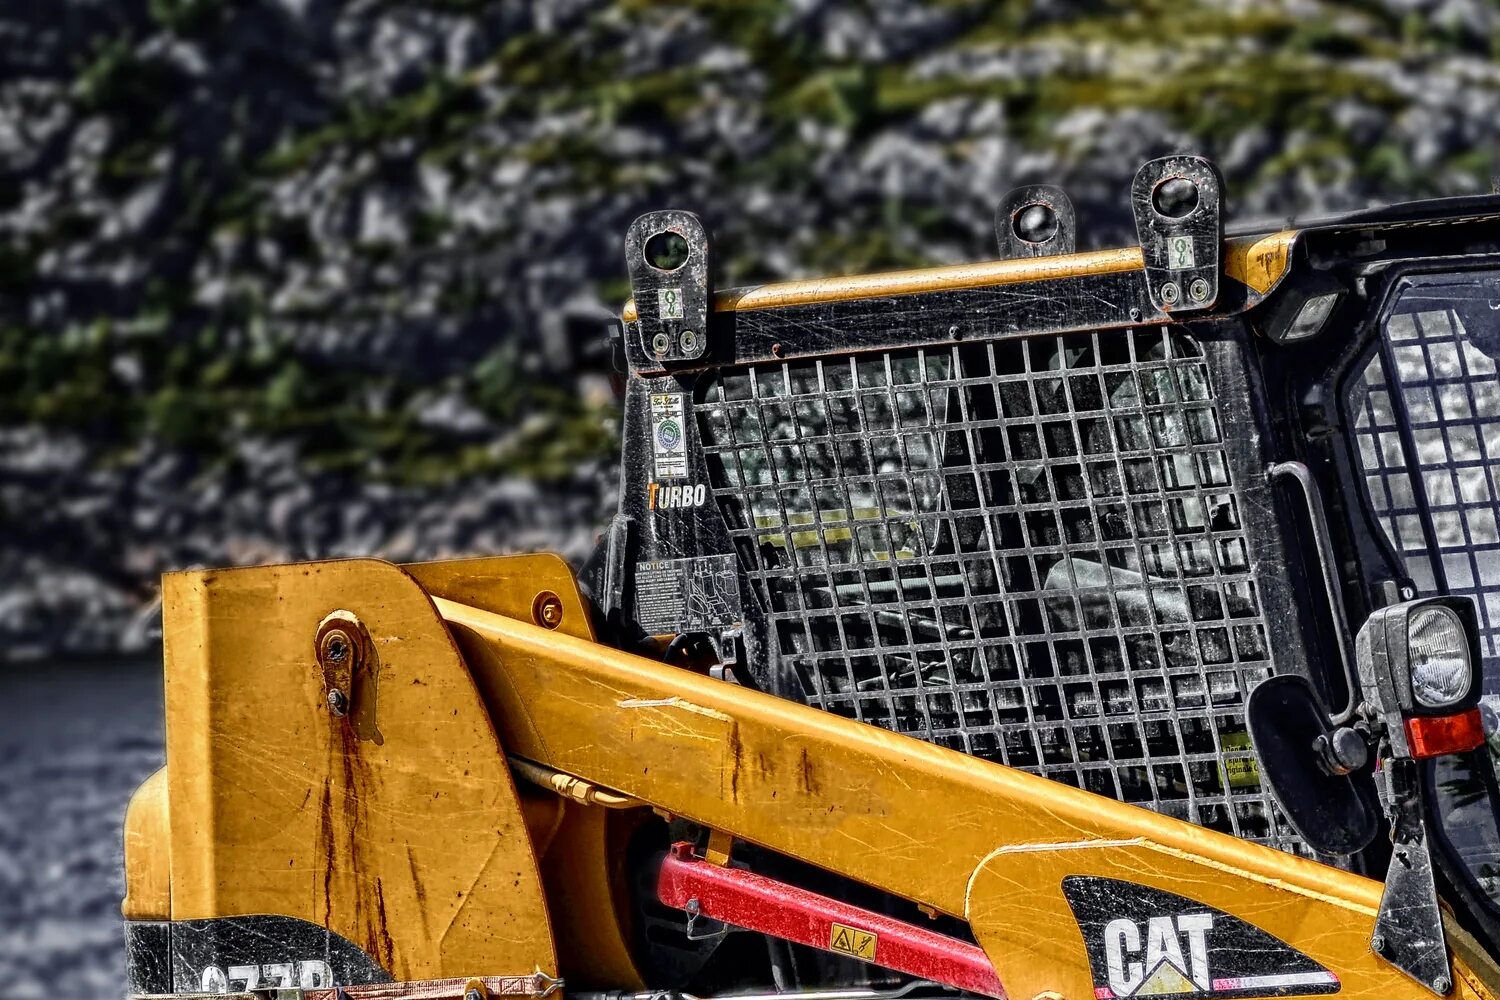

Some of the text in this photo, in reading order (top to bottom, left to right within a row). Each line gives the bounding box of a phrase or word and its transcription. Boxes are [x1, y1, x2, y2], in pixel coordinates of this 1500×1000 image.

[647, 483, 706, 511] TURBO
[639, 562, 670, 571] NOTICE
[1104, 913, 1214, 998] CAT
